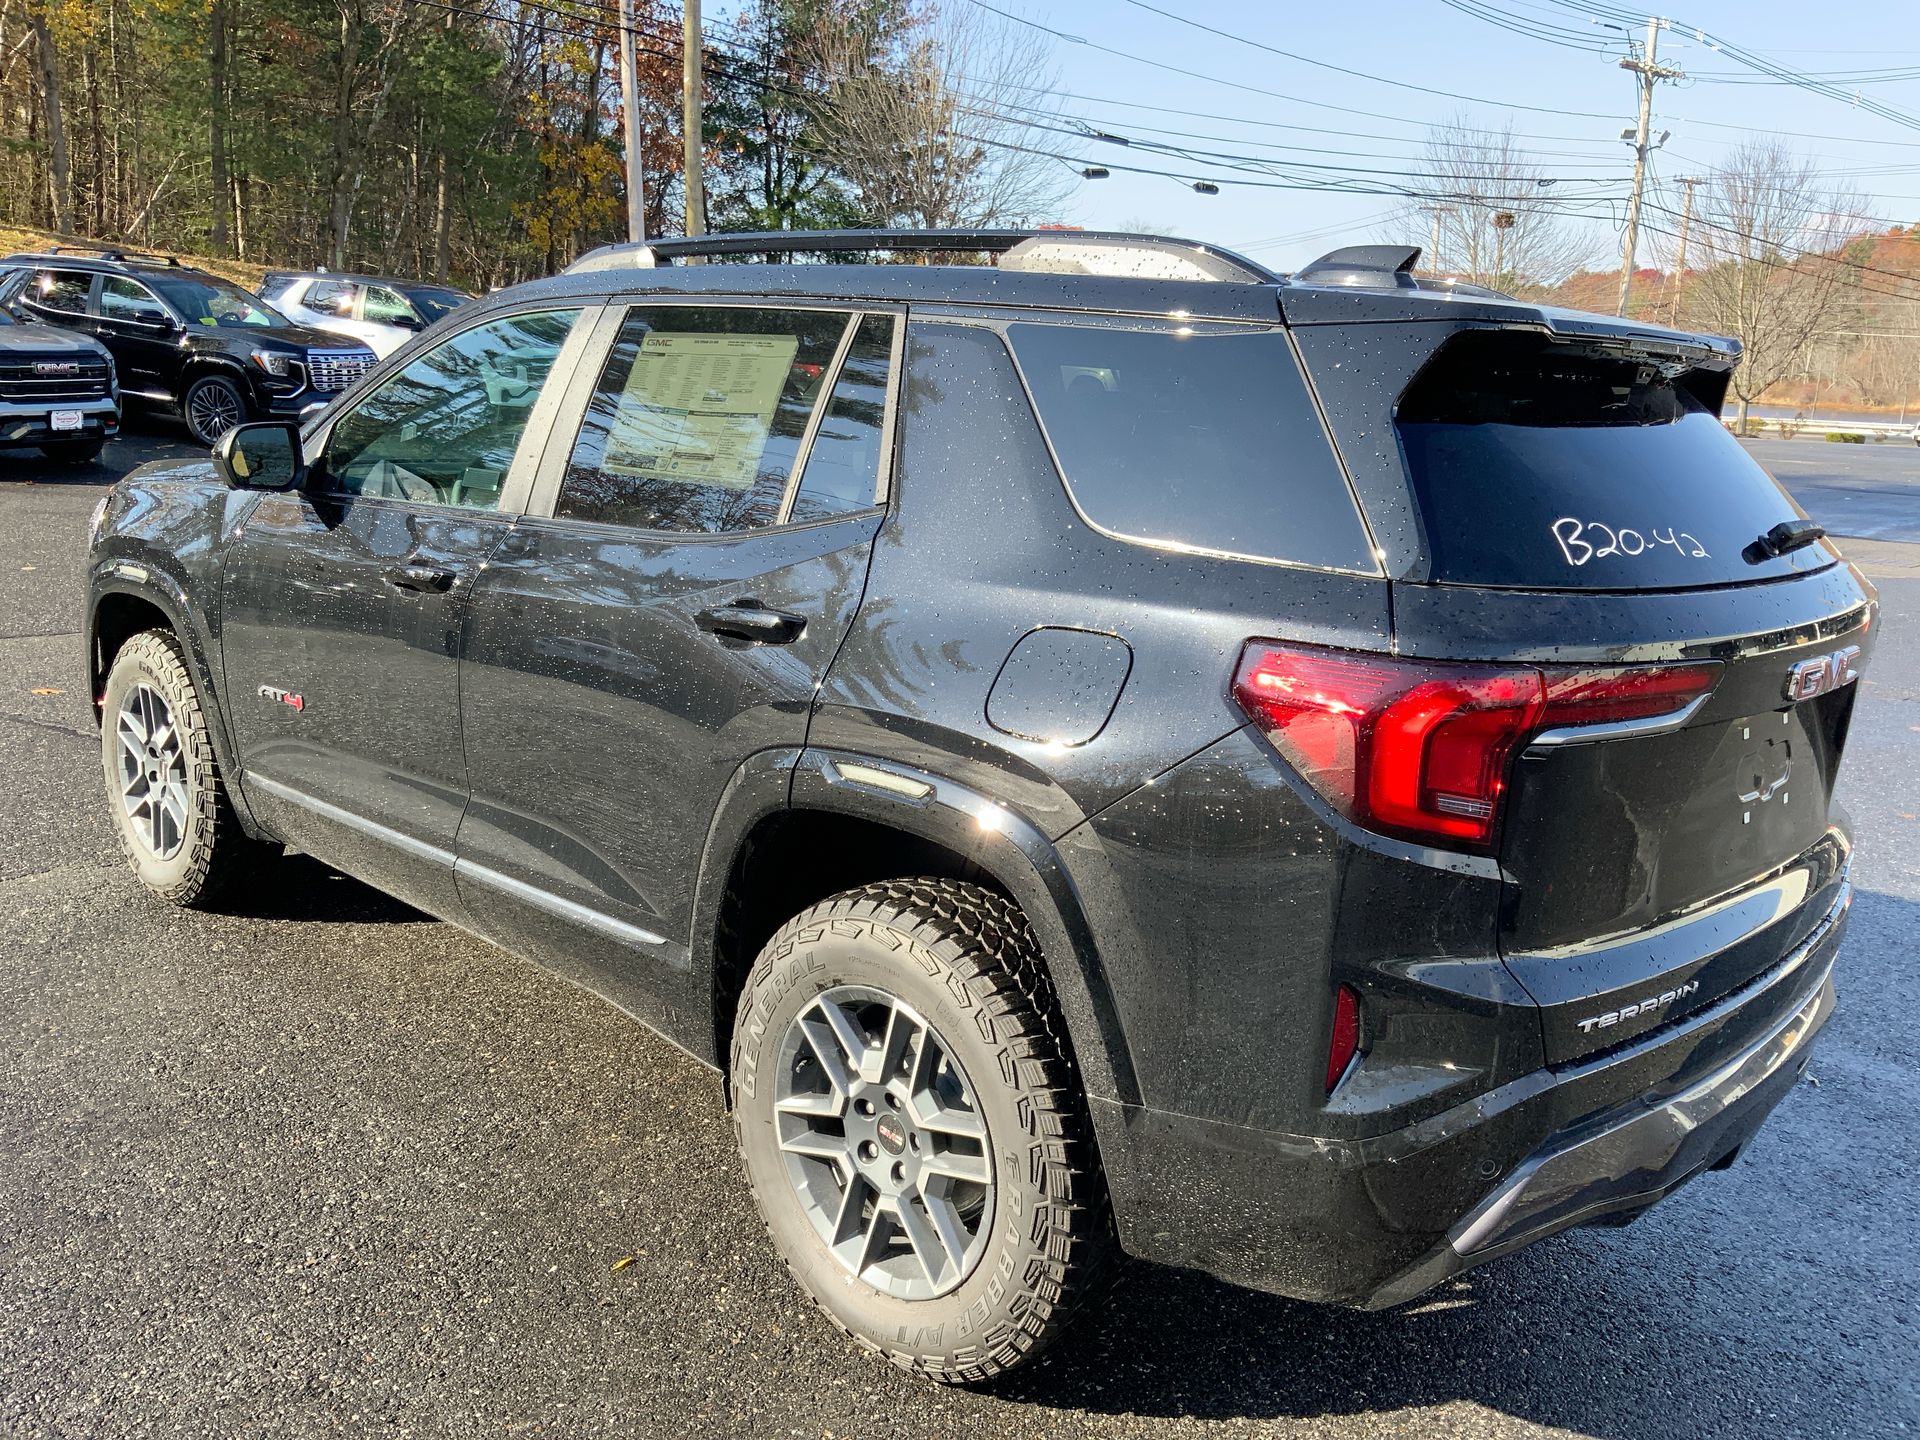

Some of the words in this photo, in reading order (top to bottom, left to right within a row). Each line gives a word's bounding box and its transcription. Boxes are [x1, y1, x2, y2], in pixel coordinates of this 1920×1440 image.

[645, 338, 673, 347] GMC
[36, 362, 79, 374] GMC
[1551, 517, 1712, 566] B20-42
[1785, 645, 1861, 701] GMC
[257, 684, 305, 713] AT4
[742, 951, 826, 1100] GENERAL
[1577, 980, 1699, 1034] TERRAIN
[891, 1322, 945, 1348] A/T
